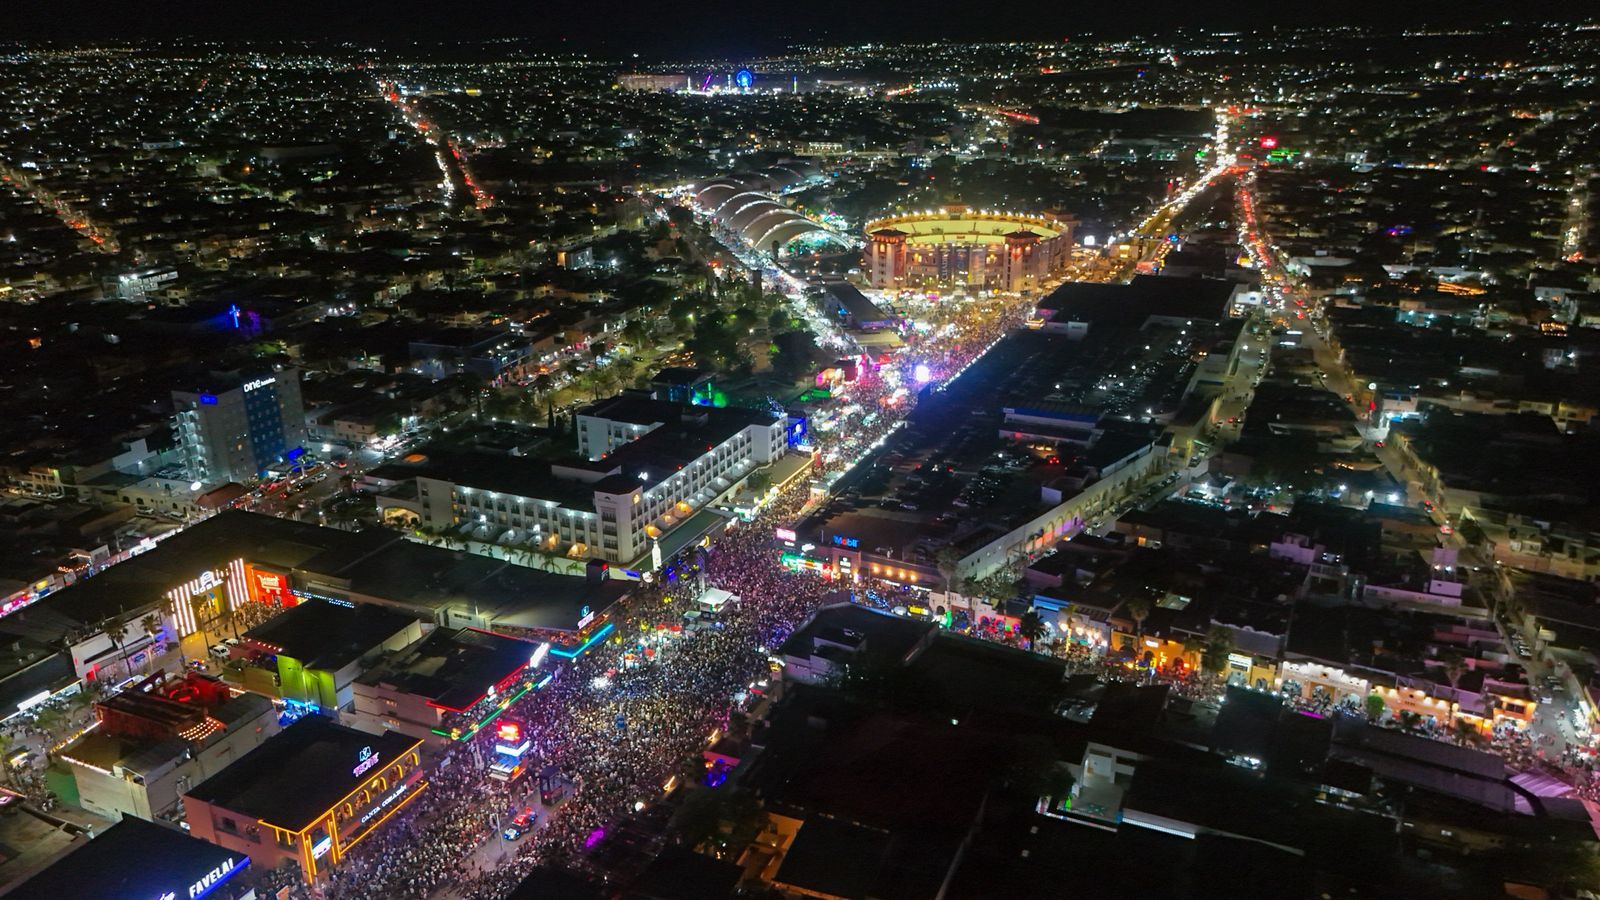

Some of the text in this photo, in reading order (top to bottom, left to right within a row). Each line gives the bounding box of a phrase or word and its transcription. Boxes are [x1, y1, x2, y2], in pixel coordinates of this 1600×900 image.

[243, 379, 261, 393] one
[833, 534, 858, 548] Mobil
[361, 806, 381, 823] CANTA
